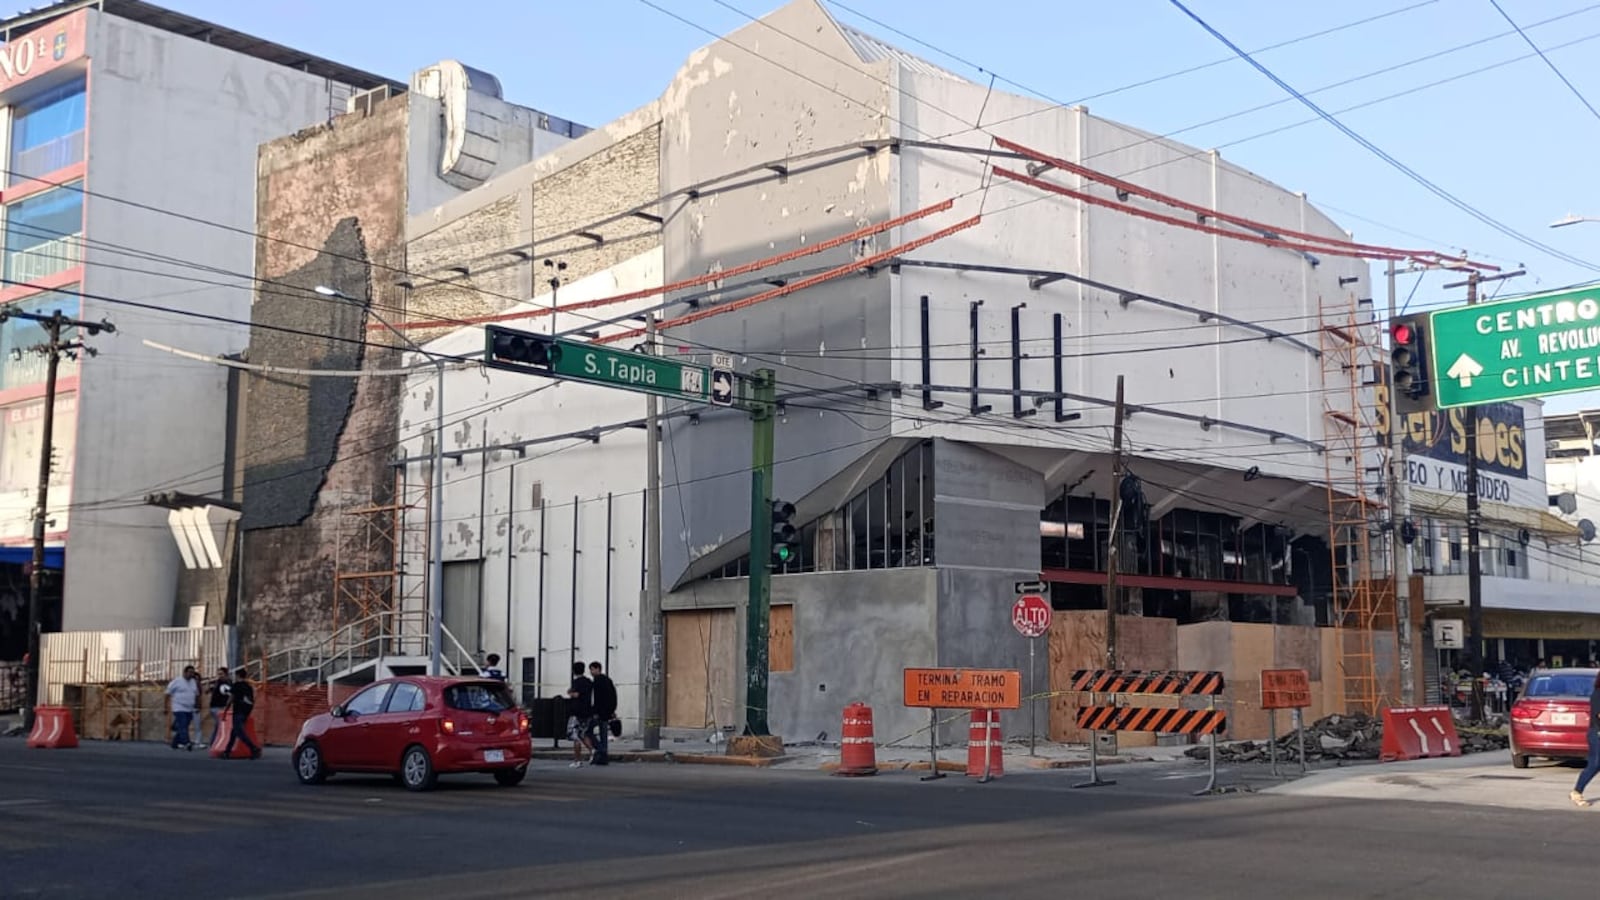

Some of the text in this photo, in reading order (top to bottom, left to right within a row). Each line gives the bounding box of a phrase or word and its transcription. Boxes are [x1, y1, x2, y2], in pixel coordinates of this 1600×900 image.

[1476, 299, 1599, 334] CENTRO
[1500, 325, 1600, 360] AV. REVOLU
[584, 353, 601, 374] S.
[607, 357, 656, 384] Tapia
[715, 355, 731, 366] OTE
[1502, 355, 1600, 387] CINTE
[1448, 407, 1523, 470] Soes
[1434, 465, 1444, 489] Y
[1450, 469, 1510, 502] MEUDEO
[1015, 607, 1048, 627] ALTO
[917, 673, 1006, 687] TERMINA TRAMO
[941, 690, 1005, 703] REPARACION
